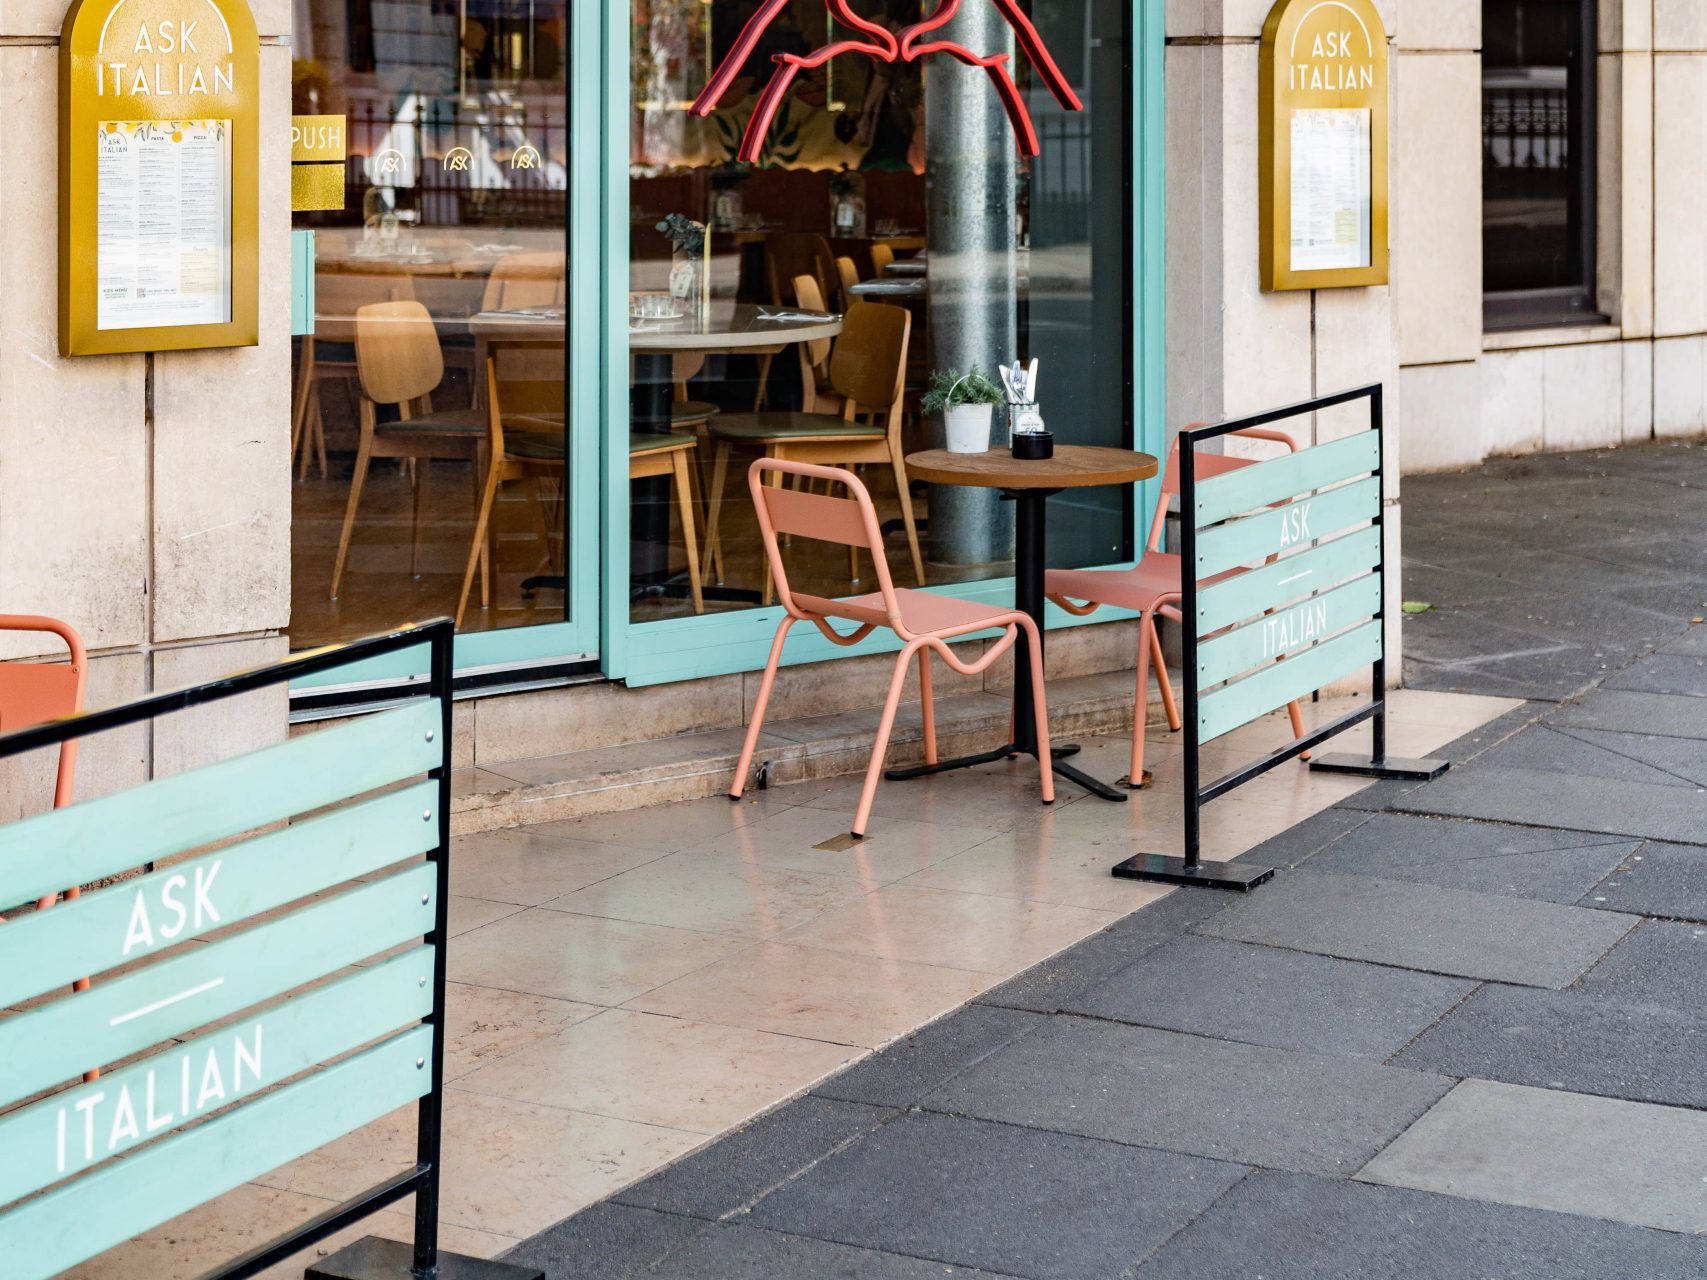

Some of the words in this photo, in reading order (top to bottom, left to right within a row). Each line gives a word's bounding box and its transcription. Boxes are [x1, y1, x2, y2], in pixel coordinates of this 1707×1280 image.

[133, 20, 199, 55] ASK
[1312, 31, 1351, 58] ASK
[97, 61, 234, 97] ITALIAN
[1290, 63, 1373, 90] ITALIAN
[292, 126, 341, 150] PUSH
[449, 155, 468, 170] ASK
[516, 154, 535, 168] ASK
[1280, 503, 1311, 547] ASK
[1263, 599, 1327, 658] ITALIAN
[122, 859, 222, 955] ASK
[56, 1024, 263, 1173] ITALIAN
